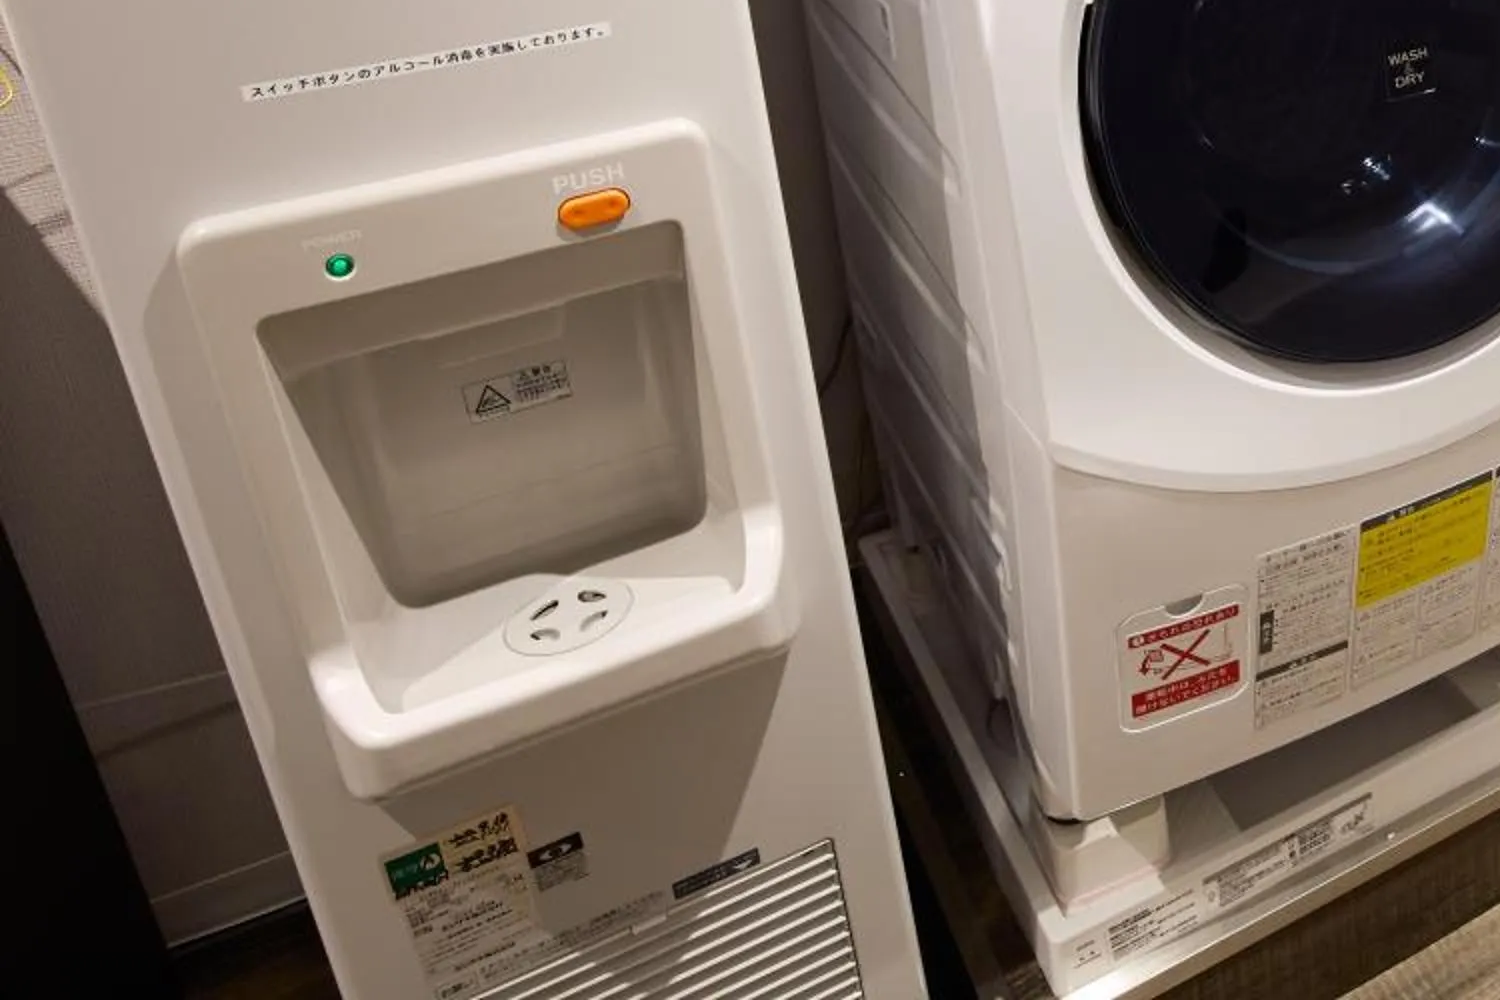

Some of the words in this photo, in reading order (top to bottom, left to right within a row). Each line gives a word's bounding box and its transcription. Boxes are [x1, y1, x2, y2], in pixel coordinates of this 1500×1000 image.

[251, 27, 605, 98] スイッチボタンのアルコール消毒を実施しております。
[1388, 47, 1428, 66] WASH
[1395, 71, 1425, 88] DRY
[552, 161, 625, 194] PUSH
